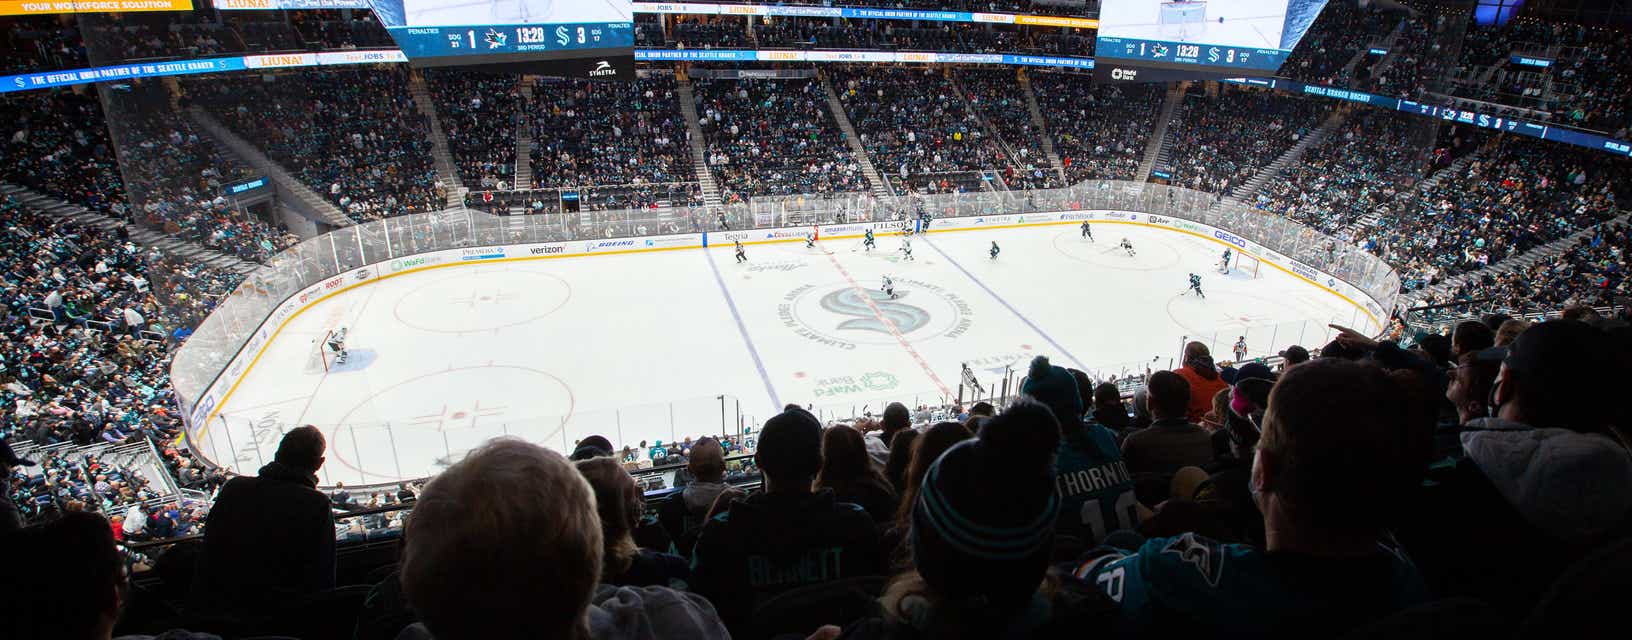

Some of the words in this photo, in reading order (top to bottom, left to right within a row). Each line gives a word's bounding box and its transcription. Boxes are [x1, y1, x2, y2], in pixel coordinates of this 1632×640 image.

[22, 3, 51, 11] YOUR
[54, 2, 120, 10] WORKFORCE
[122, 0, 172, 8] SOLUTION
[468, 30, 476, 48] 1
[516, 28, 544, 42] 13:28
[577, 28, 586, 44] 3
[1140, 43, 1145, 56] 1
[1176, 44, 1199, 58] 13:28
[1226, 49, 1235, 63] 3
[261, 56, 303, 67] LIUNA!
[31, 76, 45, 85] THE
[47, 73, 78, 84] OFFICIAL
[79, 71, 100, 81] UNION
[101, 68, 130, 78] PARTNER
[132, 67, 142, 75] OF
[143, 66, 156, 74] THE
[158, 63, 186, 73] SEATTLE
[188, 62, 214, 70] KRAKEN
[1304, 85, 1325, 95] SEATTLE
[1327, 88, 1349, 99] KRAKEN
[1350, 91, 1371, 102] HOCKEY
[724, 232, 748, 242] Tegria
[1214, 230, 1246, 248] GEICO
[530, 244, 563, 255] verizon
[1289, 260, 1318, 276] AMERICAN
[326, 278, 344, 289] ROOT
